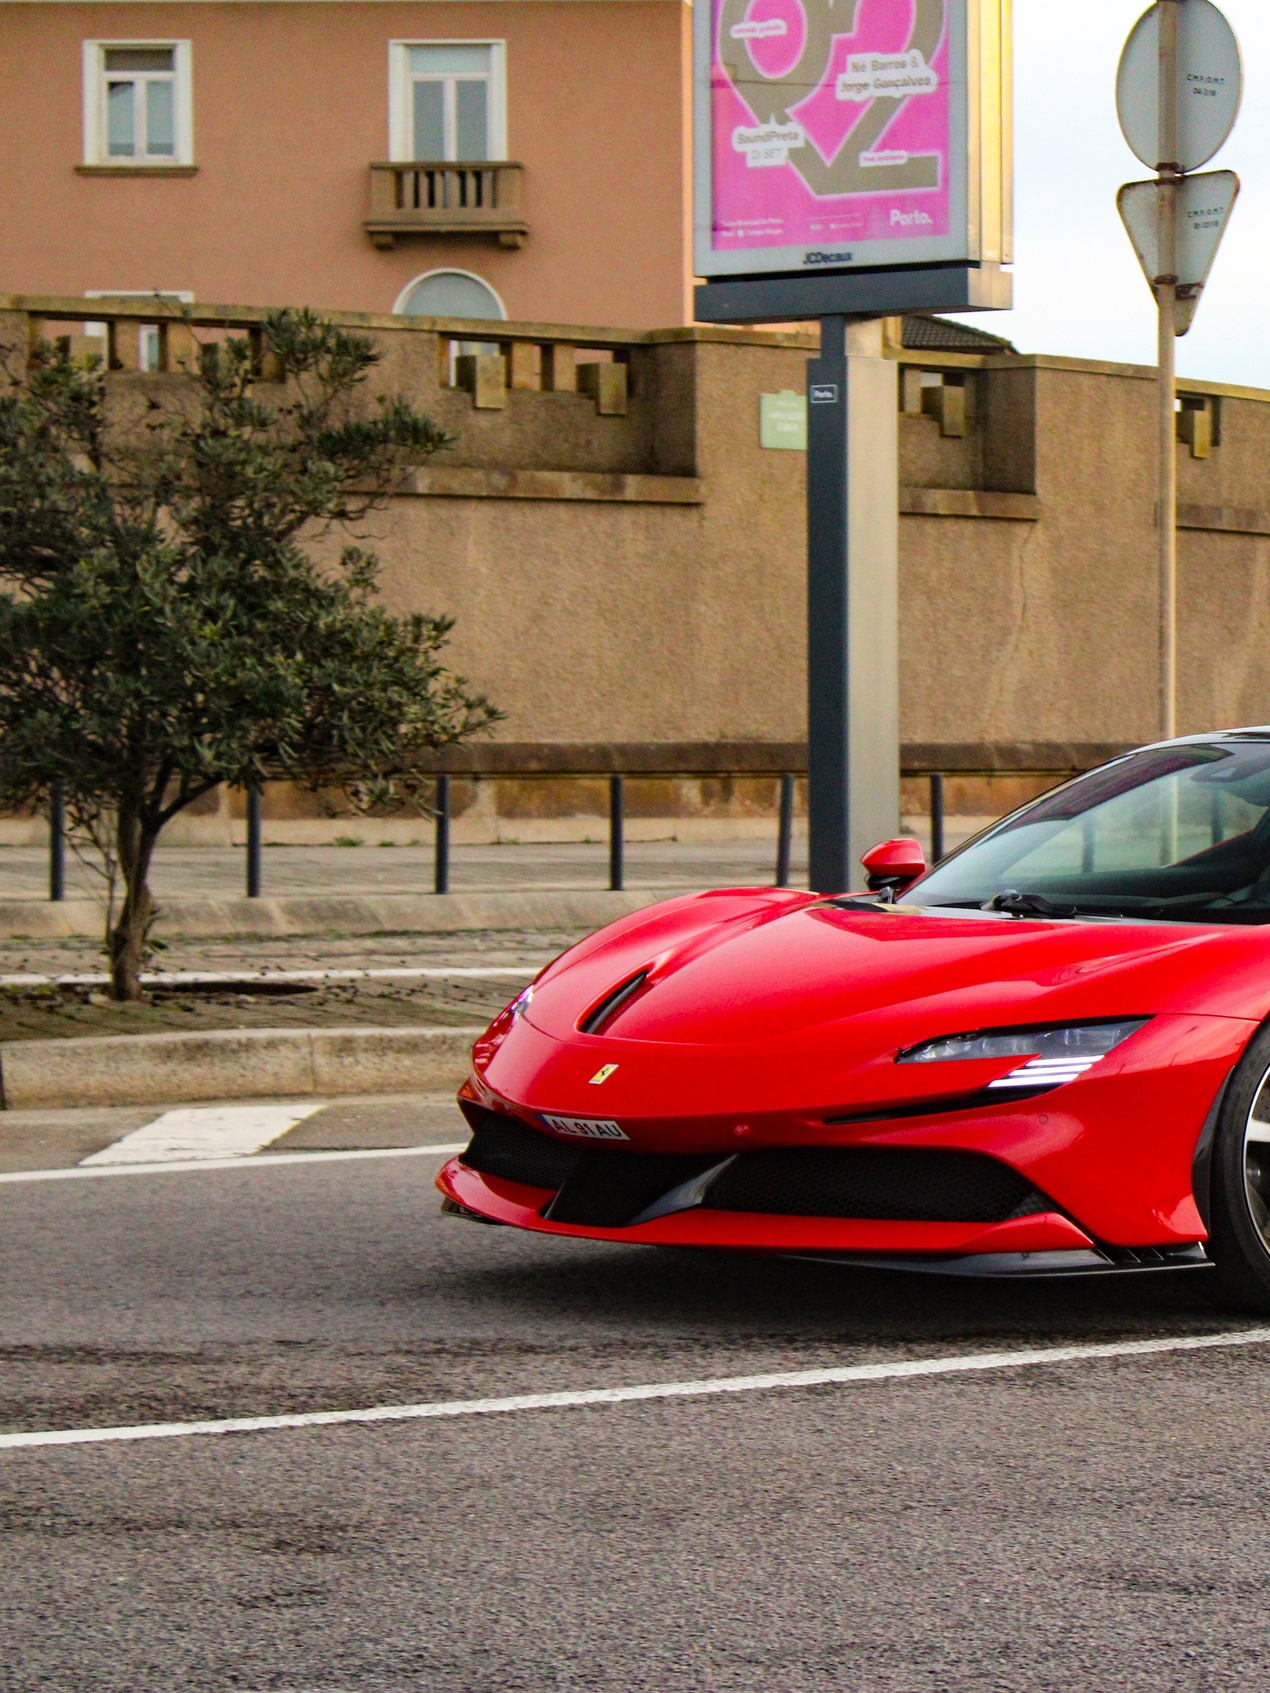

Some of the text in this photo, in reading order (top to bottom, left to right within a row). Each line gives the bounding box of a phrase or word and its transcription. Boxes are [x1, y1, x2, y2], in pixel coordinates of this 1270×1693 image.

[871, 59, 907, 71] Barros
[841, 76, 931, 95] Jorge Gonçalves
[802, 251, 853, 264] JCDecaux
[551, 1118, 622, 1138] AL 91 AU
